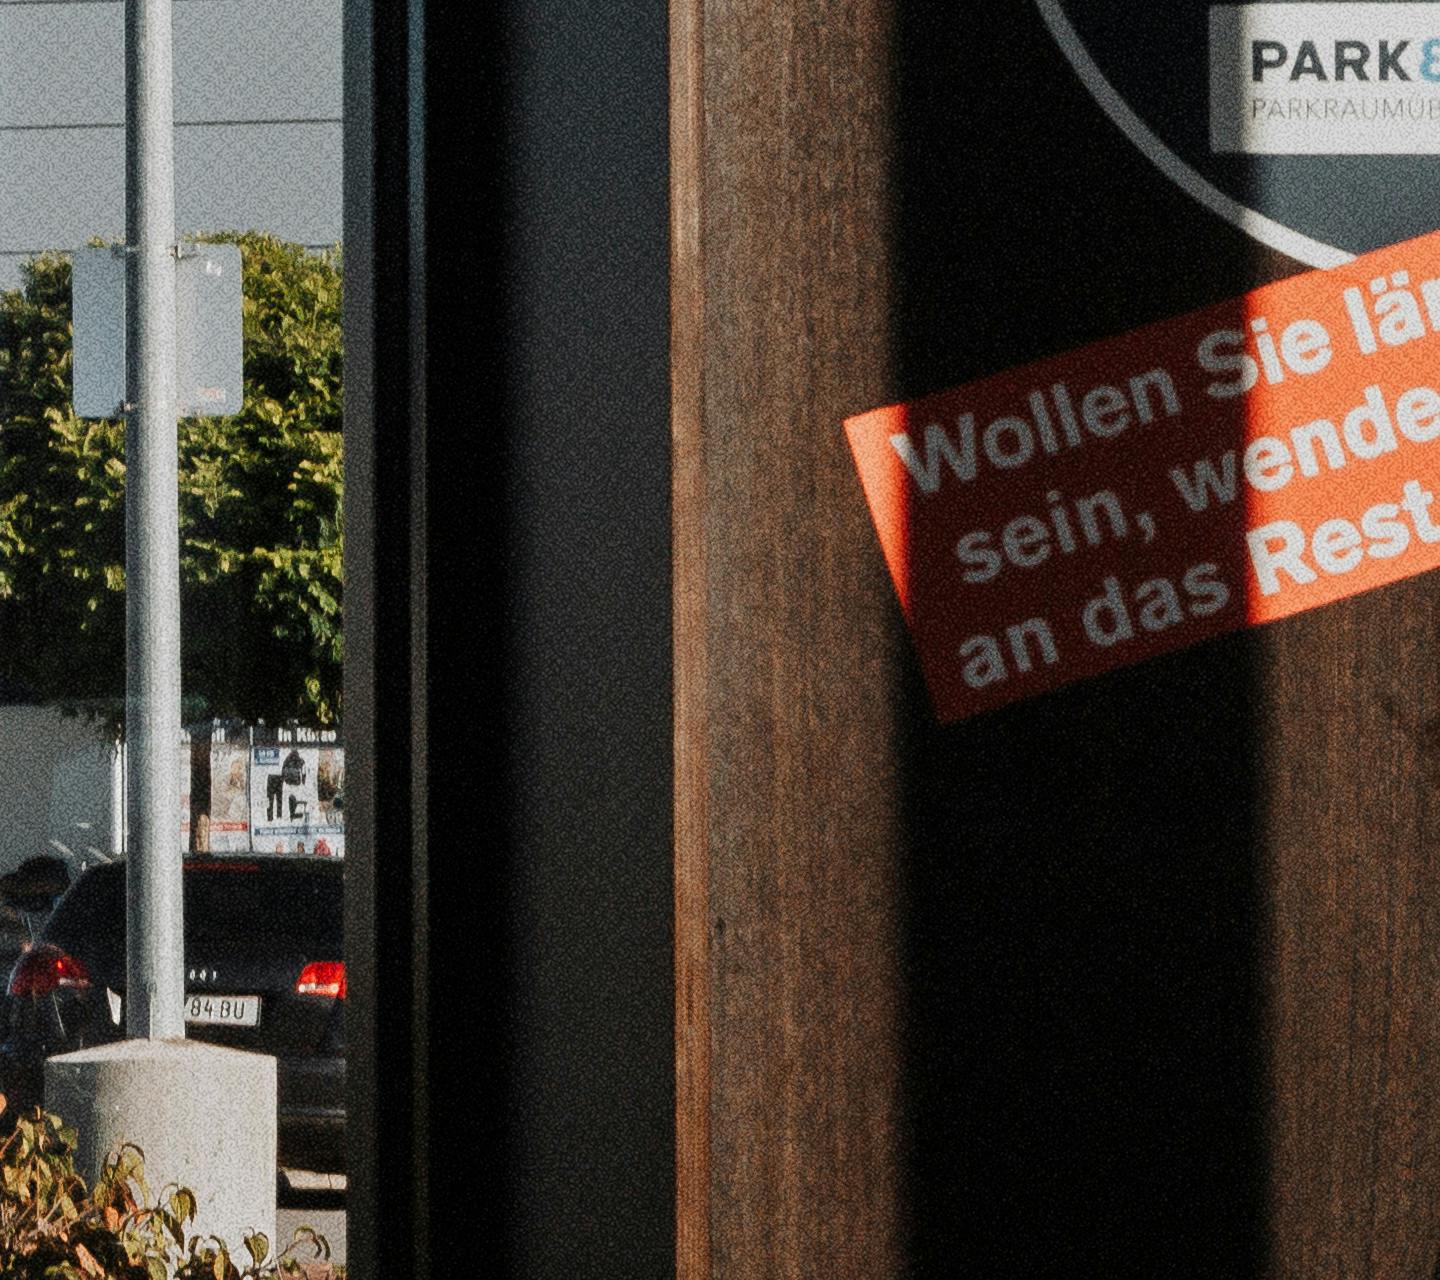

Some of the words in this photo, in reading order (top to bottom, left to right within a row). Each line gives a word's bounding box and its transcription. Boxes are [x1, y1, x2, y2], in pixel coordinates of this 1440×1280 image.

[891, 366, 1182, 497] Wollen
[1196, 309, 1333, 400] Sie
[956, 489, 1158, 584] sein,
[1173, 385, 1440, 513] wende
[958, 615, 1060, 690] an
[1082, 560, 1231, 646] das
[1245, 479, 1440, 596] Rest
